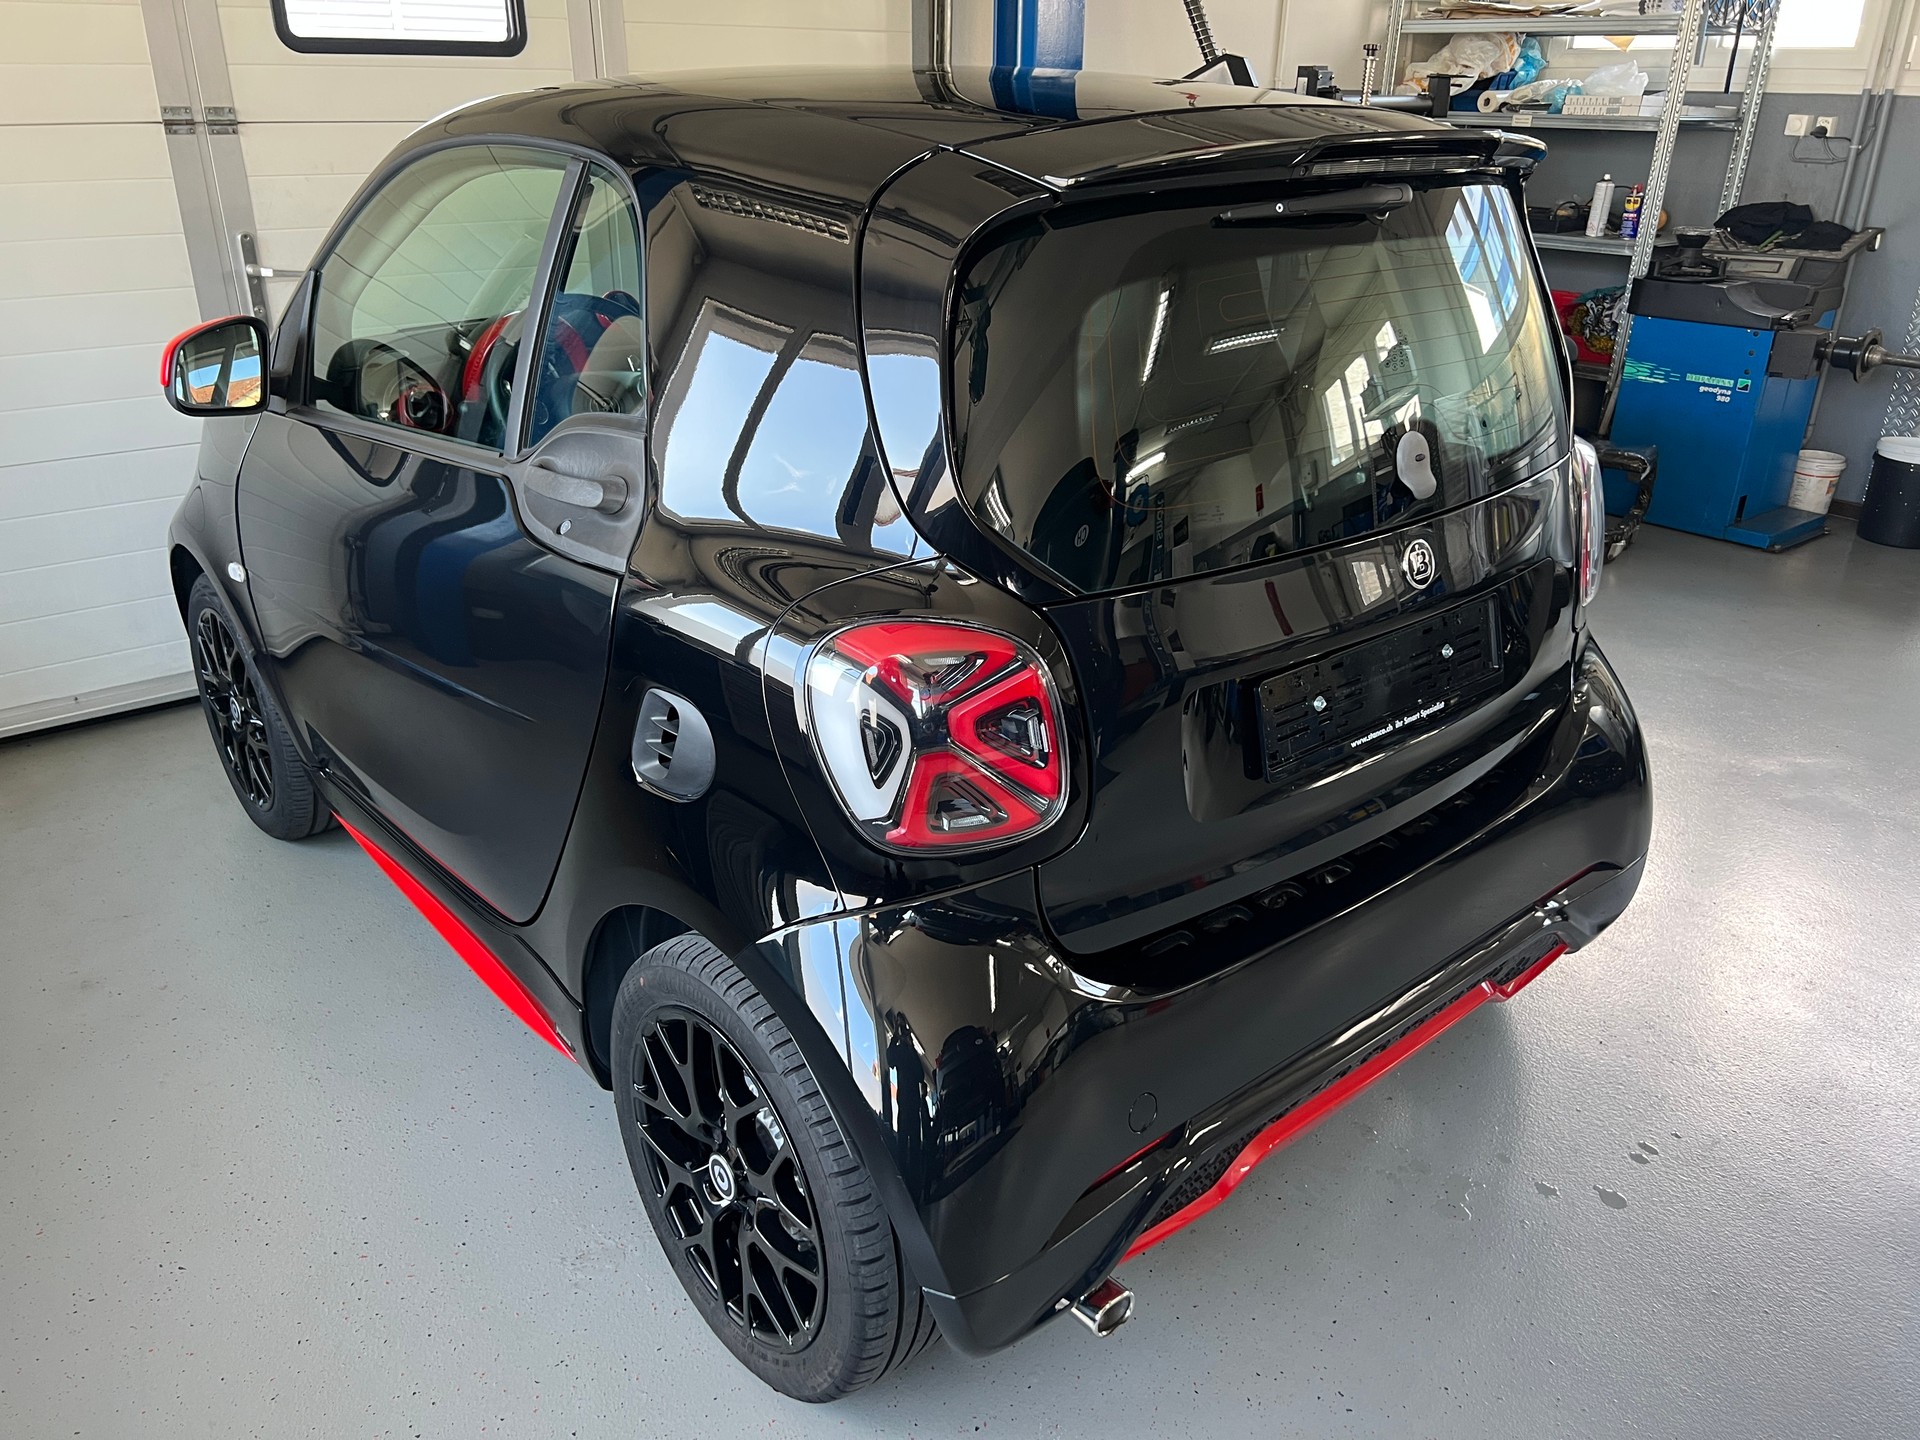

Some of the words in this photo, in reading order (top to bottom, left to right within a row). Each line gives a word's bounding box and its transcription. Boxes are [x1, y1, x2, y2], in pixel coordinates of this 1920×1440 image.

[1699, 386, 1732, 396] geodyna
[1716, 395, 1731, 403] 980
[1404, 712, 1421, 725] Smart
[1420, 701, 1445, 718] Spezialist
